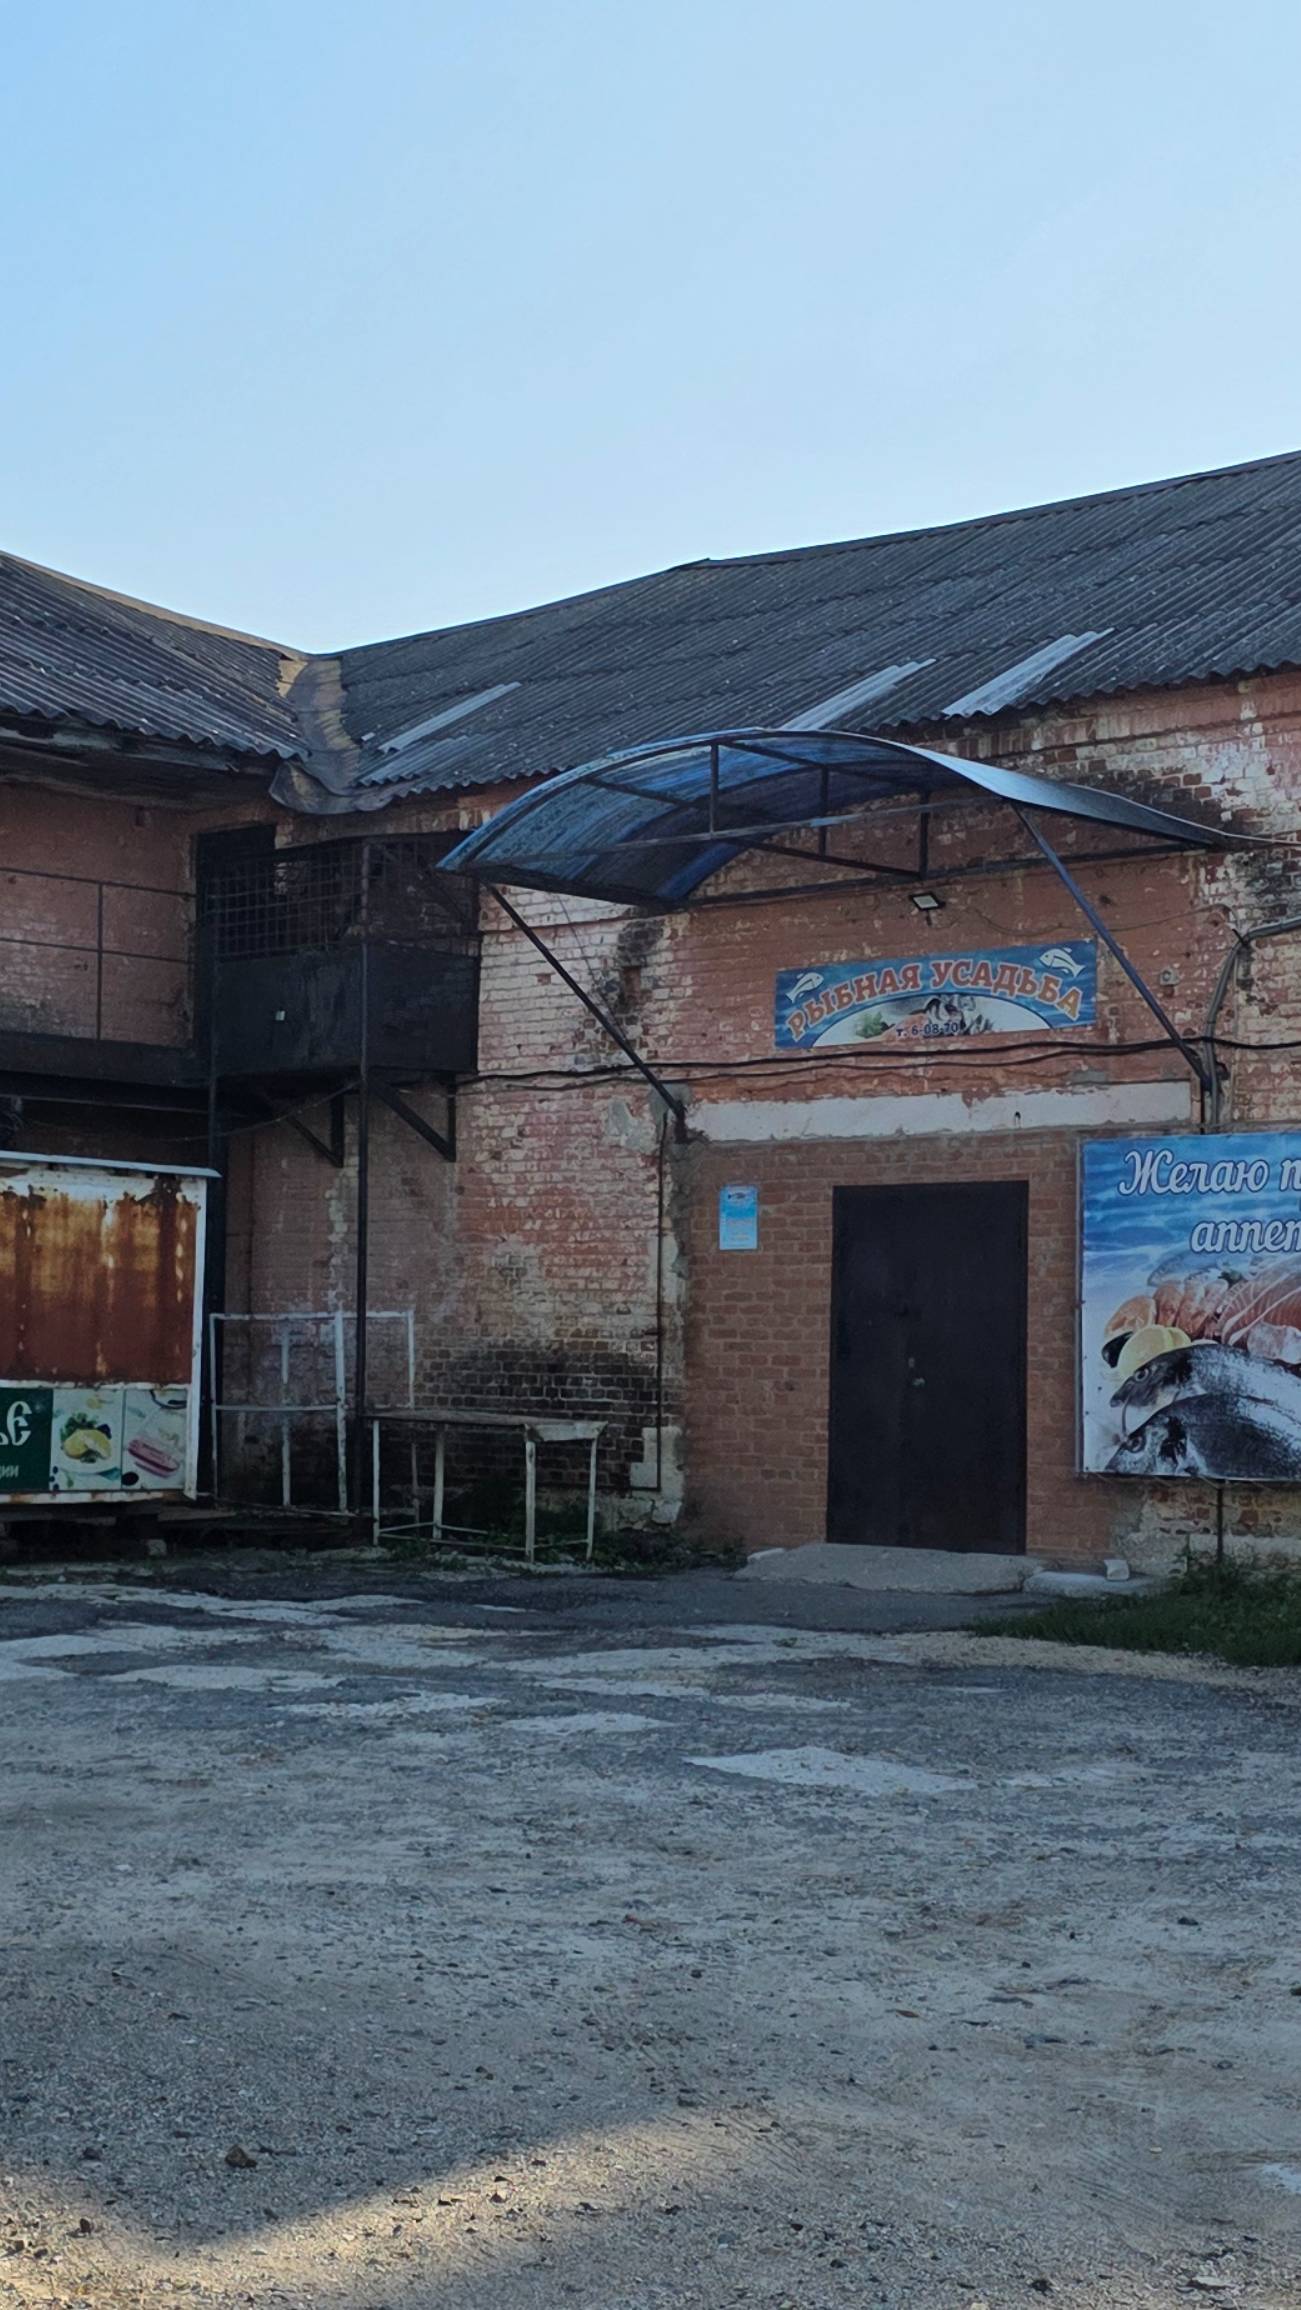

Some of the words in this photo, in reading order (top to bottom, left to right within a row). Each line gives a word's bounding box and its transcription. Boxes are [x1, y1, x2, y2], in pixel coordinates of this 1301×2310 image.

[786, 963, 921, 1041] РЫБНАЯ
[931, 960, 1083, 1020] УСАДЬБА
[1118, 1149, 1269, 1195] Желаю
